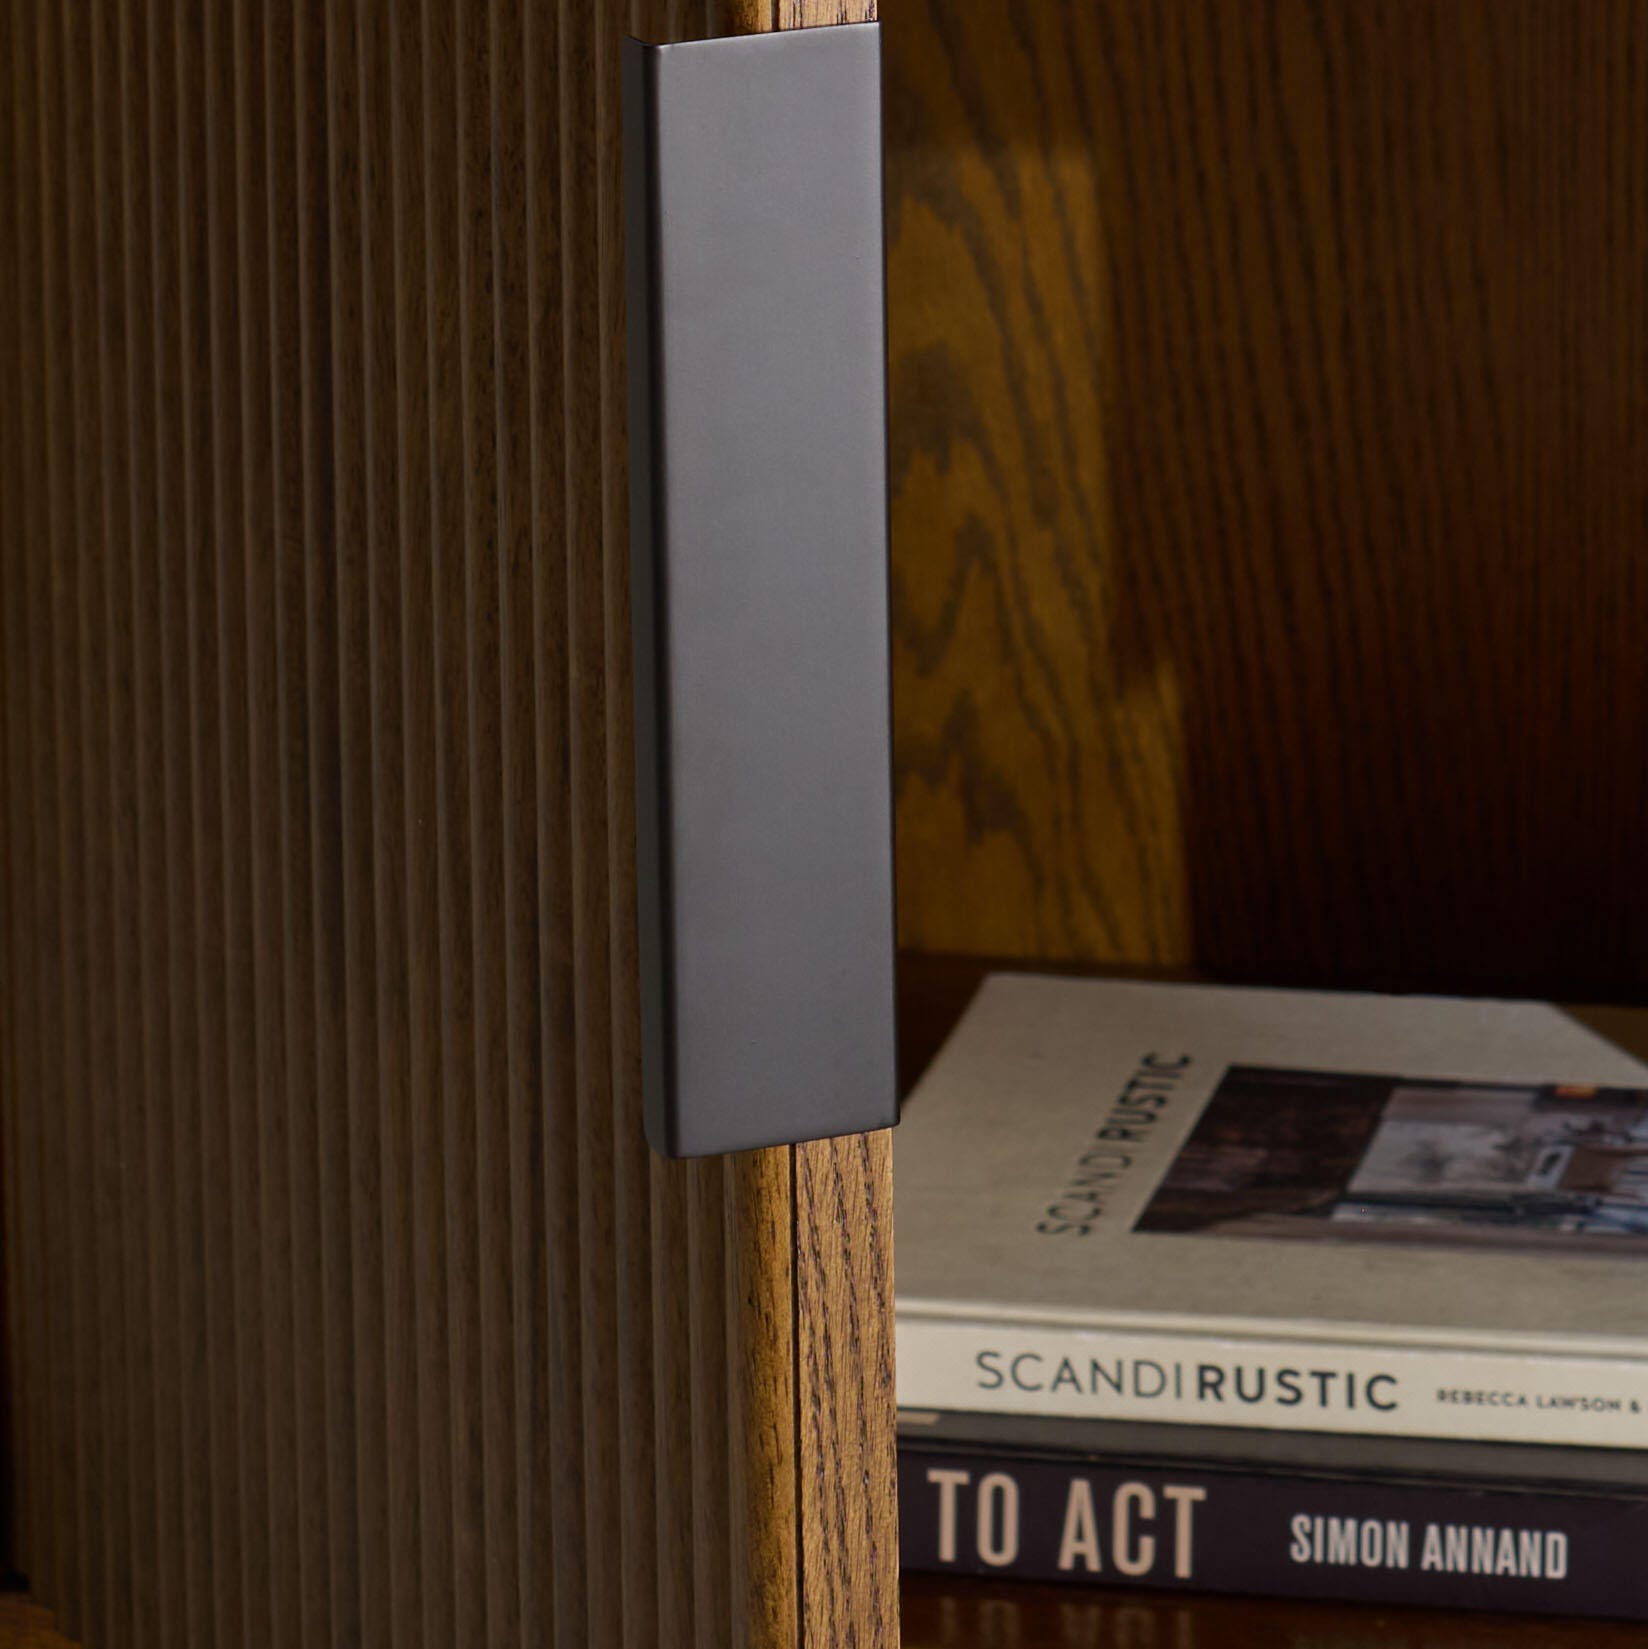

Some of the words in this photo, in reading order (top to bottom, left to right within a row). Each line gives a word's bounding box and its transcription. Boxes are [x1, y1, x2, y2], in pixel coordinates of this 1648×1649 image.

[1435, 1388, 1529, 1409] REBECCA
[1535, 1394, 1622, 1413] LAWSON
[1628, 1399, 1641, 1414] &
[926, 1468, 1020, 1567] TO
[1057, 1477, 1207, 1579] ACT
[1290, 1512, 1410, 1570] SIMON
[1420, 1523, 1569, 1580] ANNAND
